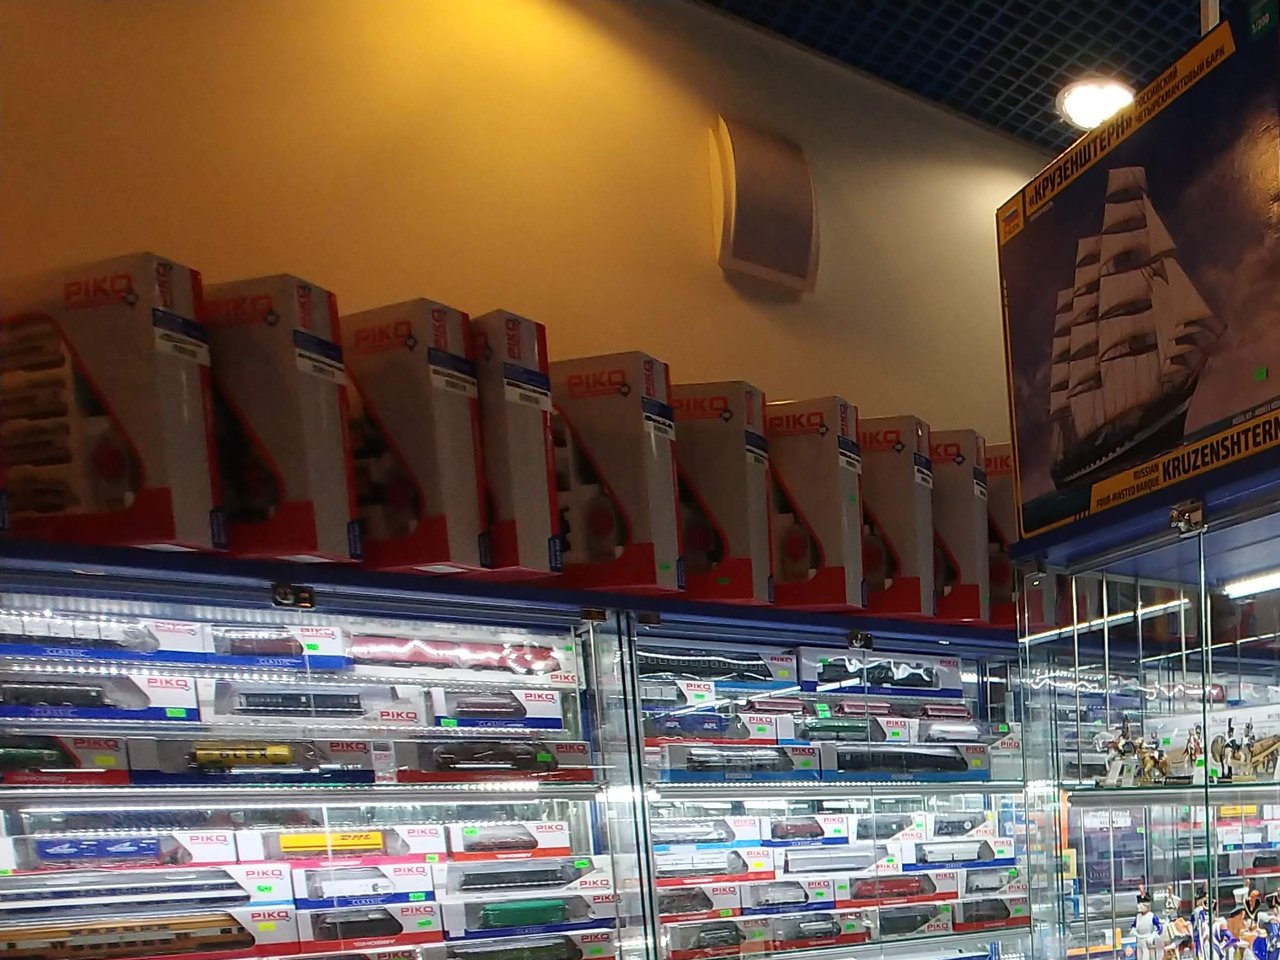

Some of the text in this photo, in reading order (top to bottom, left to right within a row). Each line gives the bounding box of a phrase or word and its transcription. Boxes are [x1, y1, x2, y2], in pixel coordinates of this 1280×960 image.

[1206, 44, 1225, 70] БАРК
[1028, 116, 1133, 208] «КРУЗЕНШТЕРН»
[64, 274, 132, 303] PIKO
[354, 320, 413, 347] PIKO
[567, 370, 626, 393] PIKO
[768, 412, 824, 431] PIKO
[859, 430, 901, 450] IKO
[985, 455, 1013, 473] PIK
[147, 678, 188, 688] PIKO
[524, 693, 555, 702] PIKO
[380, 711, 418, 720] PIKO
[748, 716, 773, 724] PIKO
[330, 742, 368, 752] PIKO
[791, 747, 815, 755] PIKO
[536, 825, 564, 833] PIKO
[189, 835, 227, 843] PIKO
[246, 870, 283, 878] PIKO
[393, 867, 425, 875] PIKO
[579, 880, 609, 888] PIKO
[712, 887, 736, 895] PIKO
[251, 911, 289, 921] PIKO
[401, 907, 433, 916] PIKO
[927, 923, 949, 931] PIKO
[581, 933, 609, 942] PIKO
[377, 952, 413, 960] PIKO
